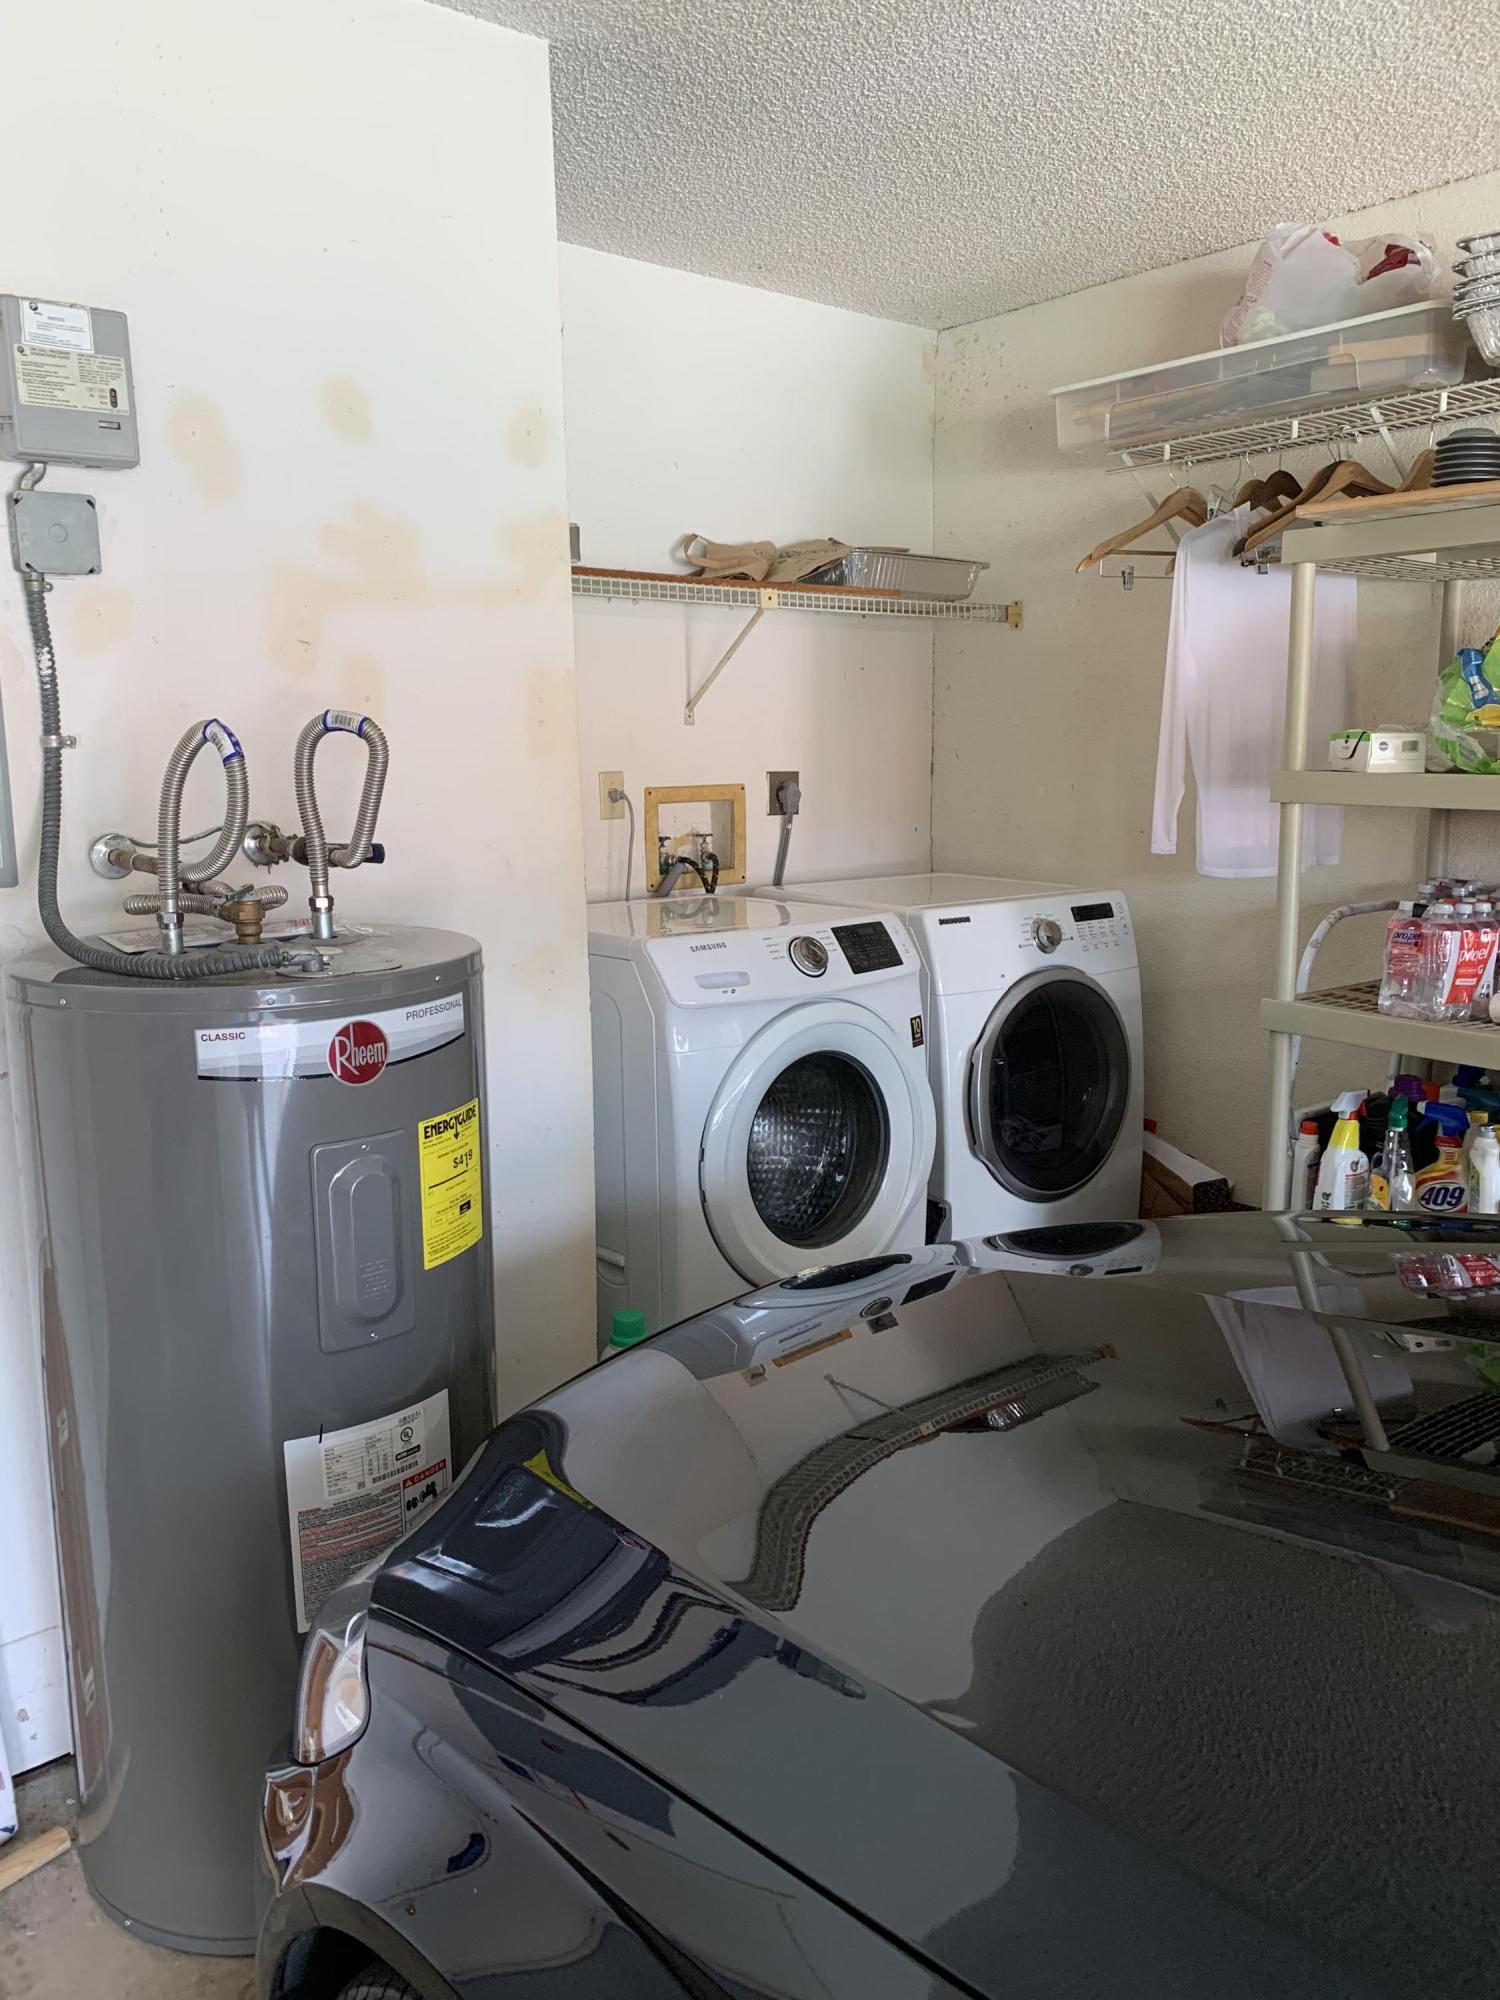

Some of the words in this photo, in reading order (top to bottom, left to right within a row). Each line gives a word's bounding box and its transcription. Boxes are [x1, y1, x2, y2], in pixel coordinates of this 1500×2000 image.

[689, 941, 727, 953] SAMSUNG
[405, 998, 463, 1021] PROFESSIONAL
[911, 1017, 921, 1034] 10
[200, 1031, 246, 1042] CLASSIC
[333, 1023, 387, 1076] Rheem
[1419, 1186, 1466, 1207] 409
[414, 1460, 445, 1483] DANGER
